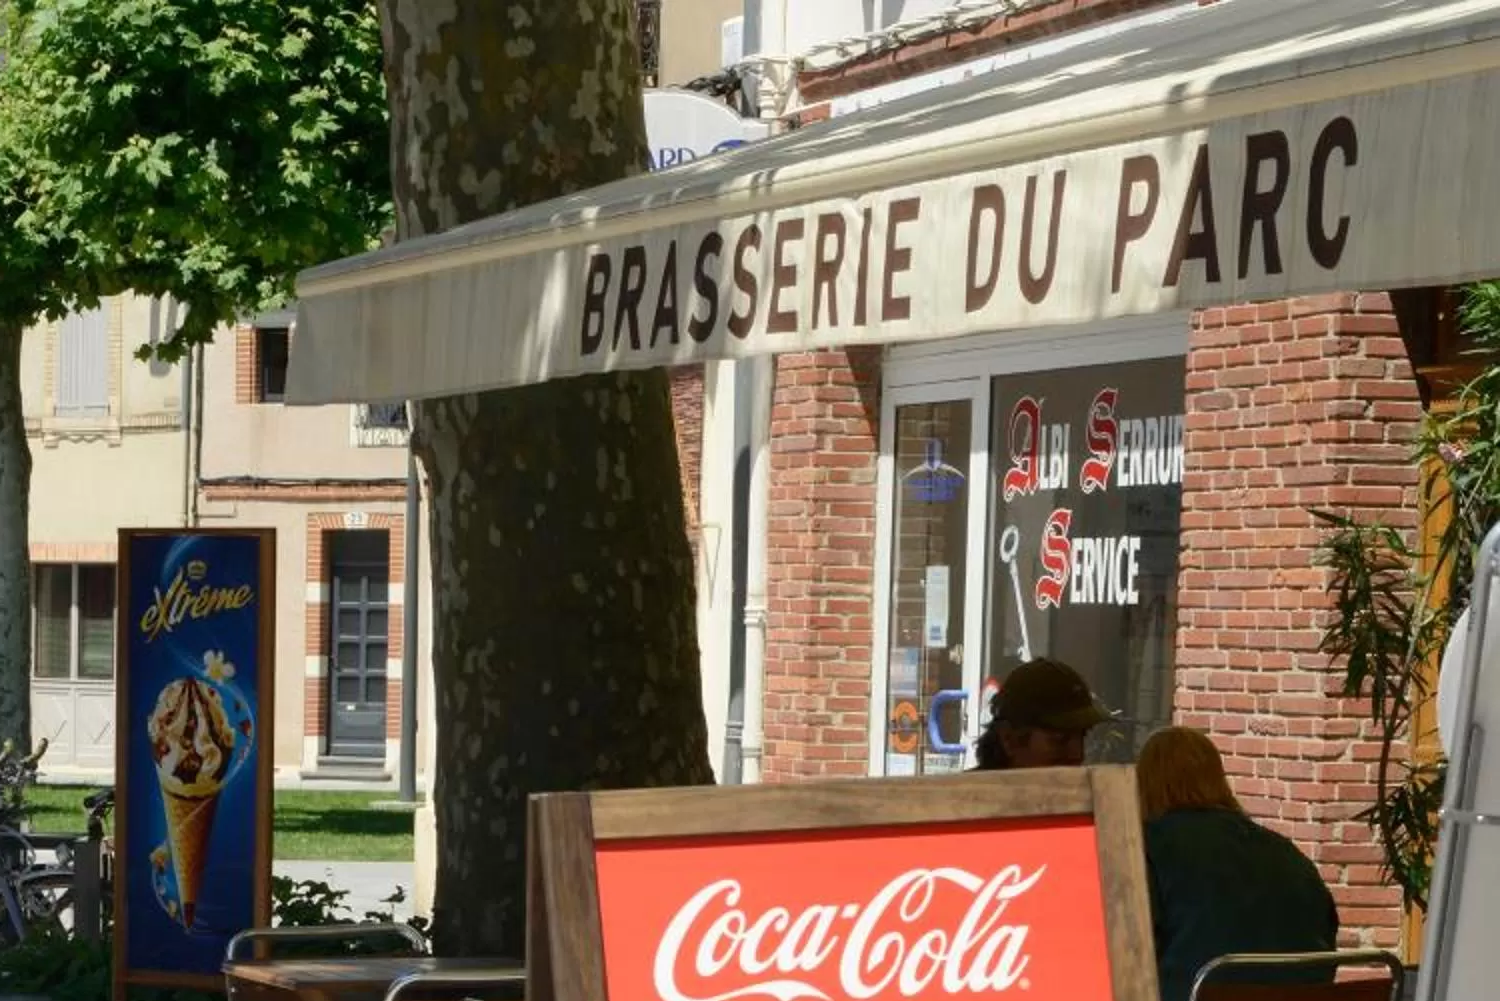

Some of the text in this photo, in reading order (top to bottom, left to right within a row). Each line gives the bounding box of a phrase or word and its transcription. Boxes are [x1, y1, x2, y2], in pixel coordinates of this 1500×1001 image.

[580, 116, 1360, 356] BRASSERIE DU PARC
[1004, 395, 1071, 502] ALBI
[1035, 508, 1141, 609] SERVICE
